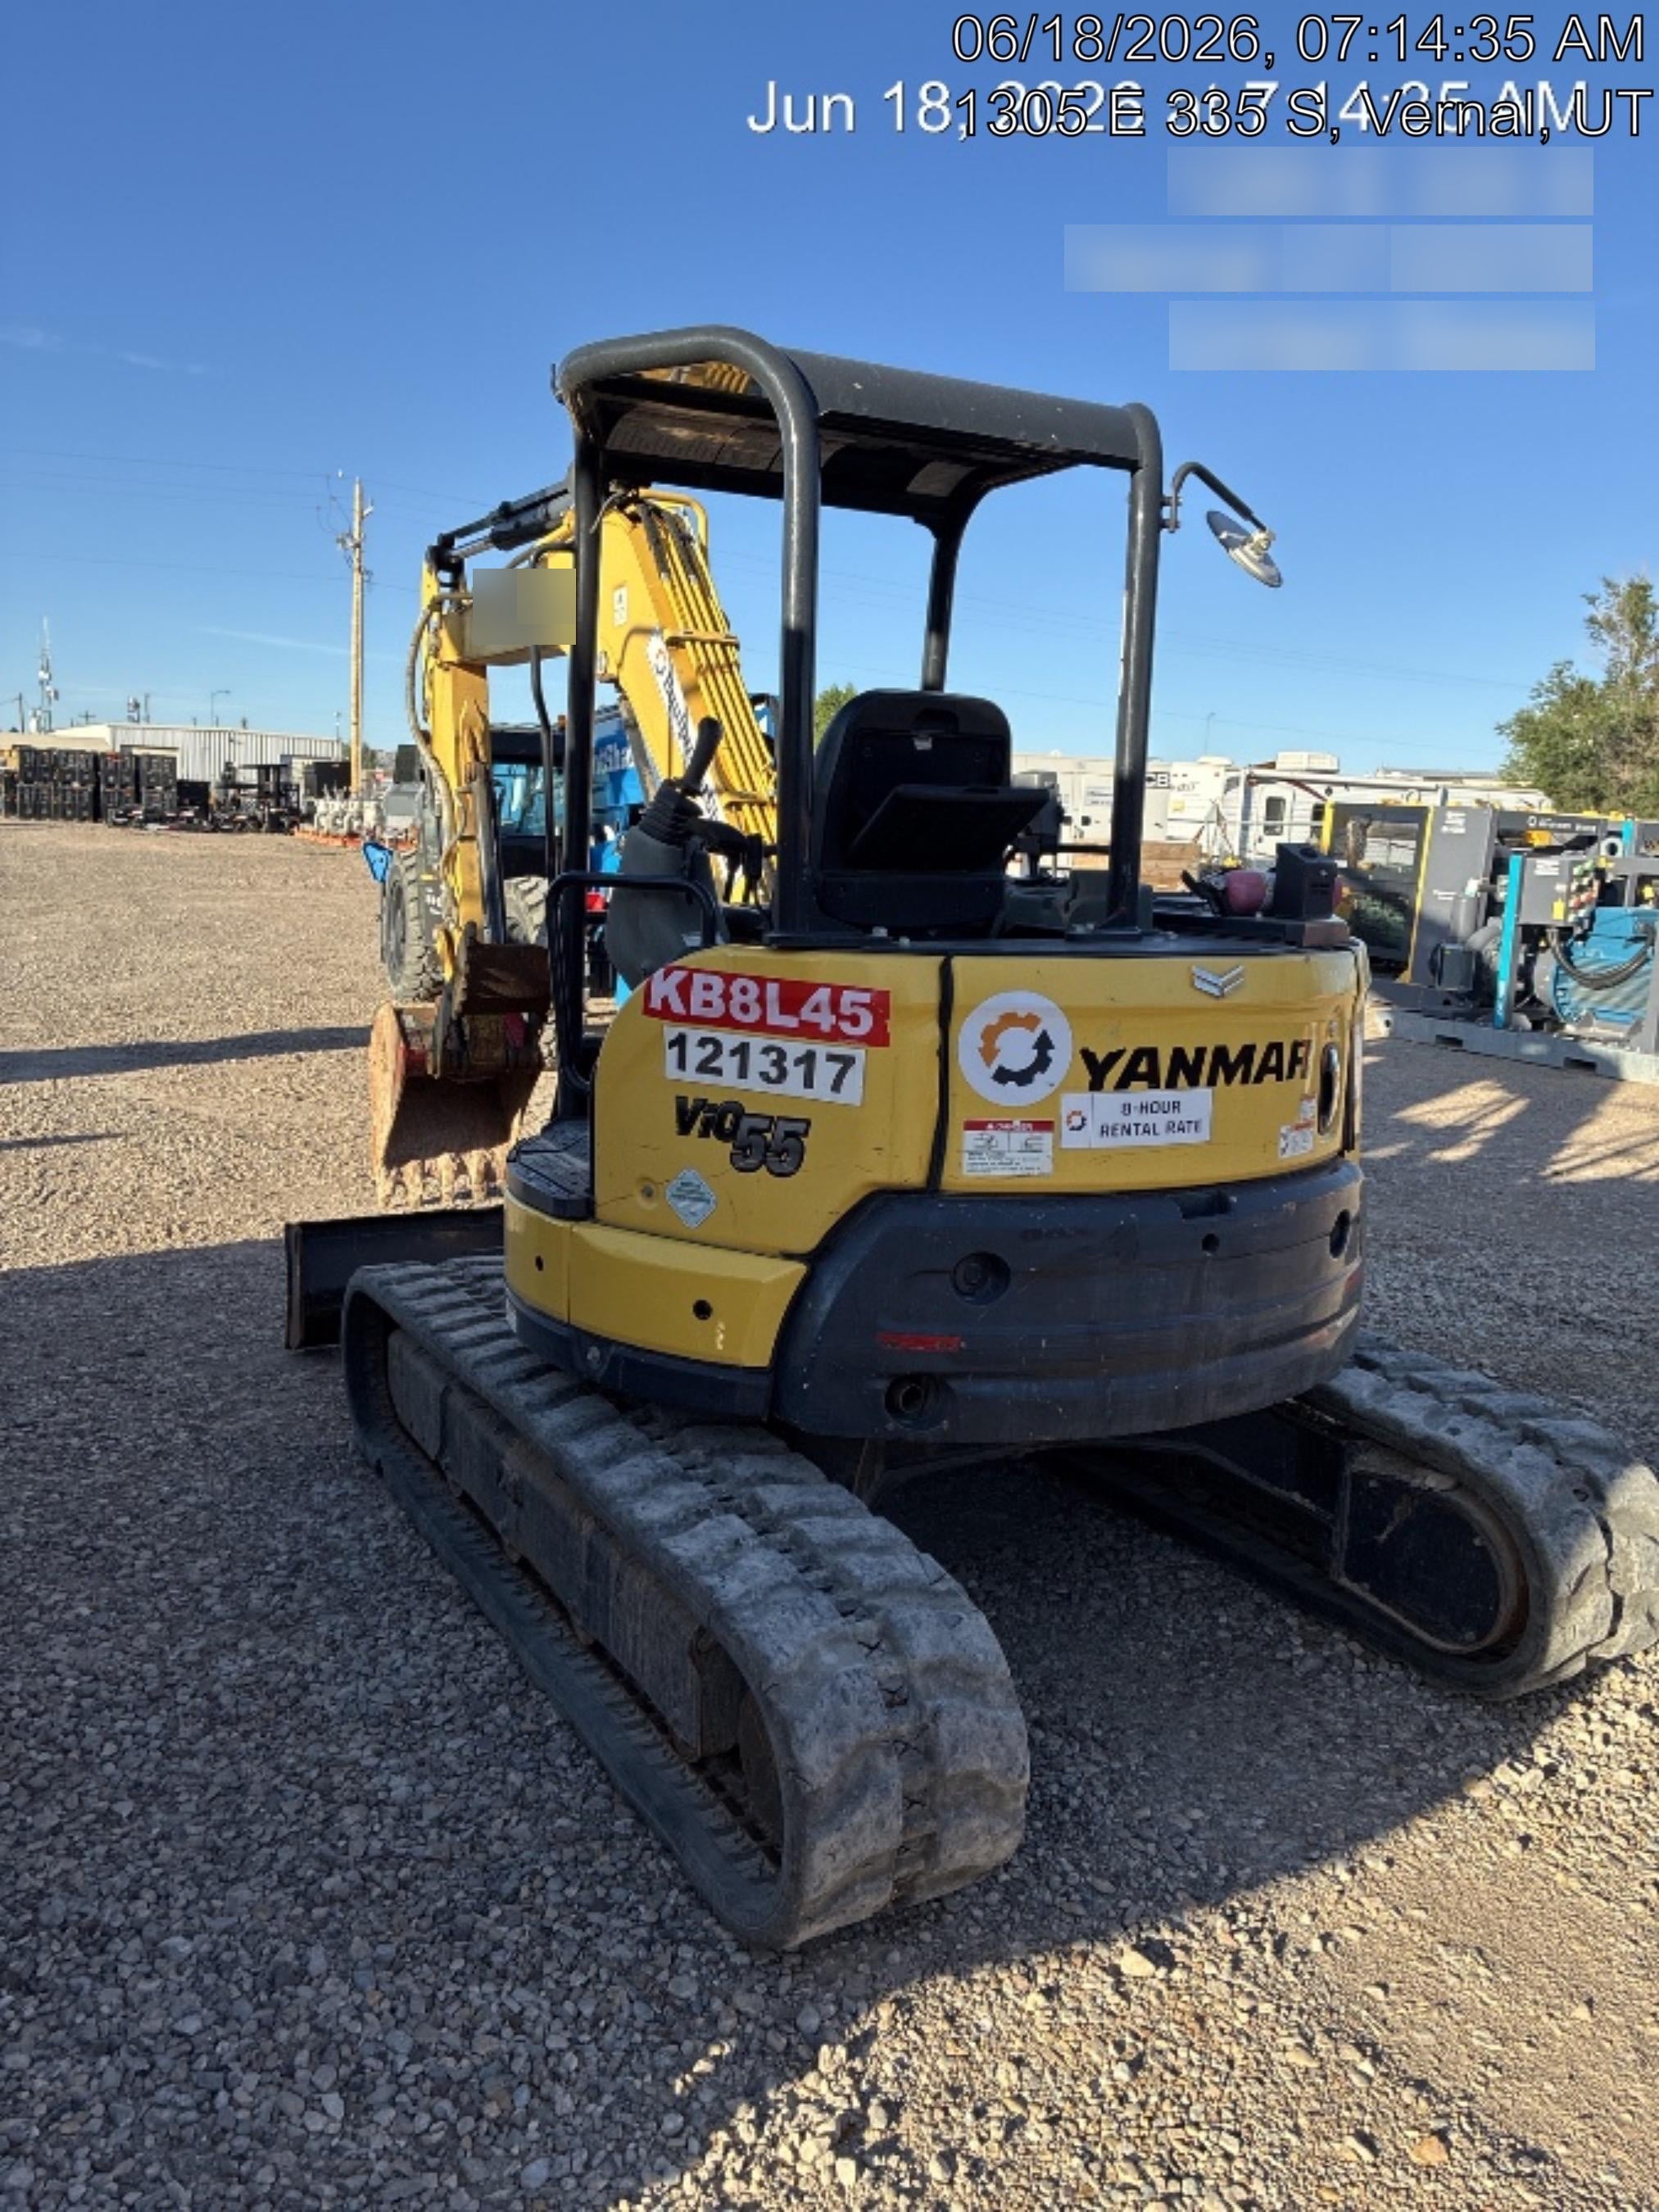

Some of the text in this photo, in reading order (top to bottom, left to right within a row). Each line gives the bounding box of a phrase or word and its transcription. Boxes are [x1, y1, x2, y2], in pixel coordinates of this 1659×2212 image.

[647, 968, 874, 1036] KB8L45
[667, 1031, 857, 1094] 121317
[1079, 1039, 1312, 1091] YANMAR
[1099, 1118, 1203, 1138] RENTAL RATE
